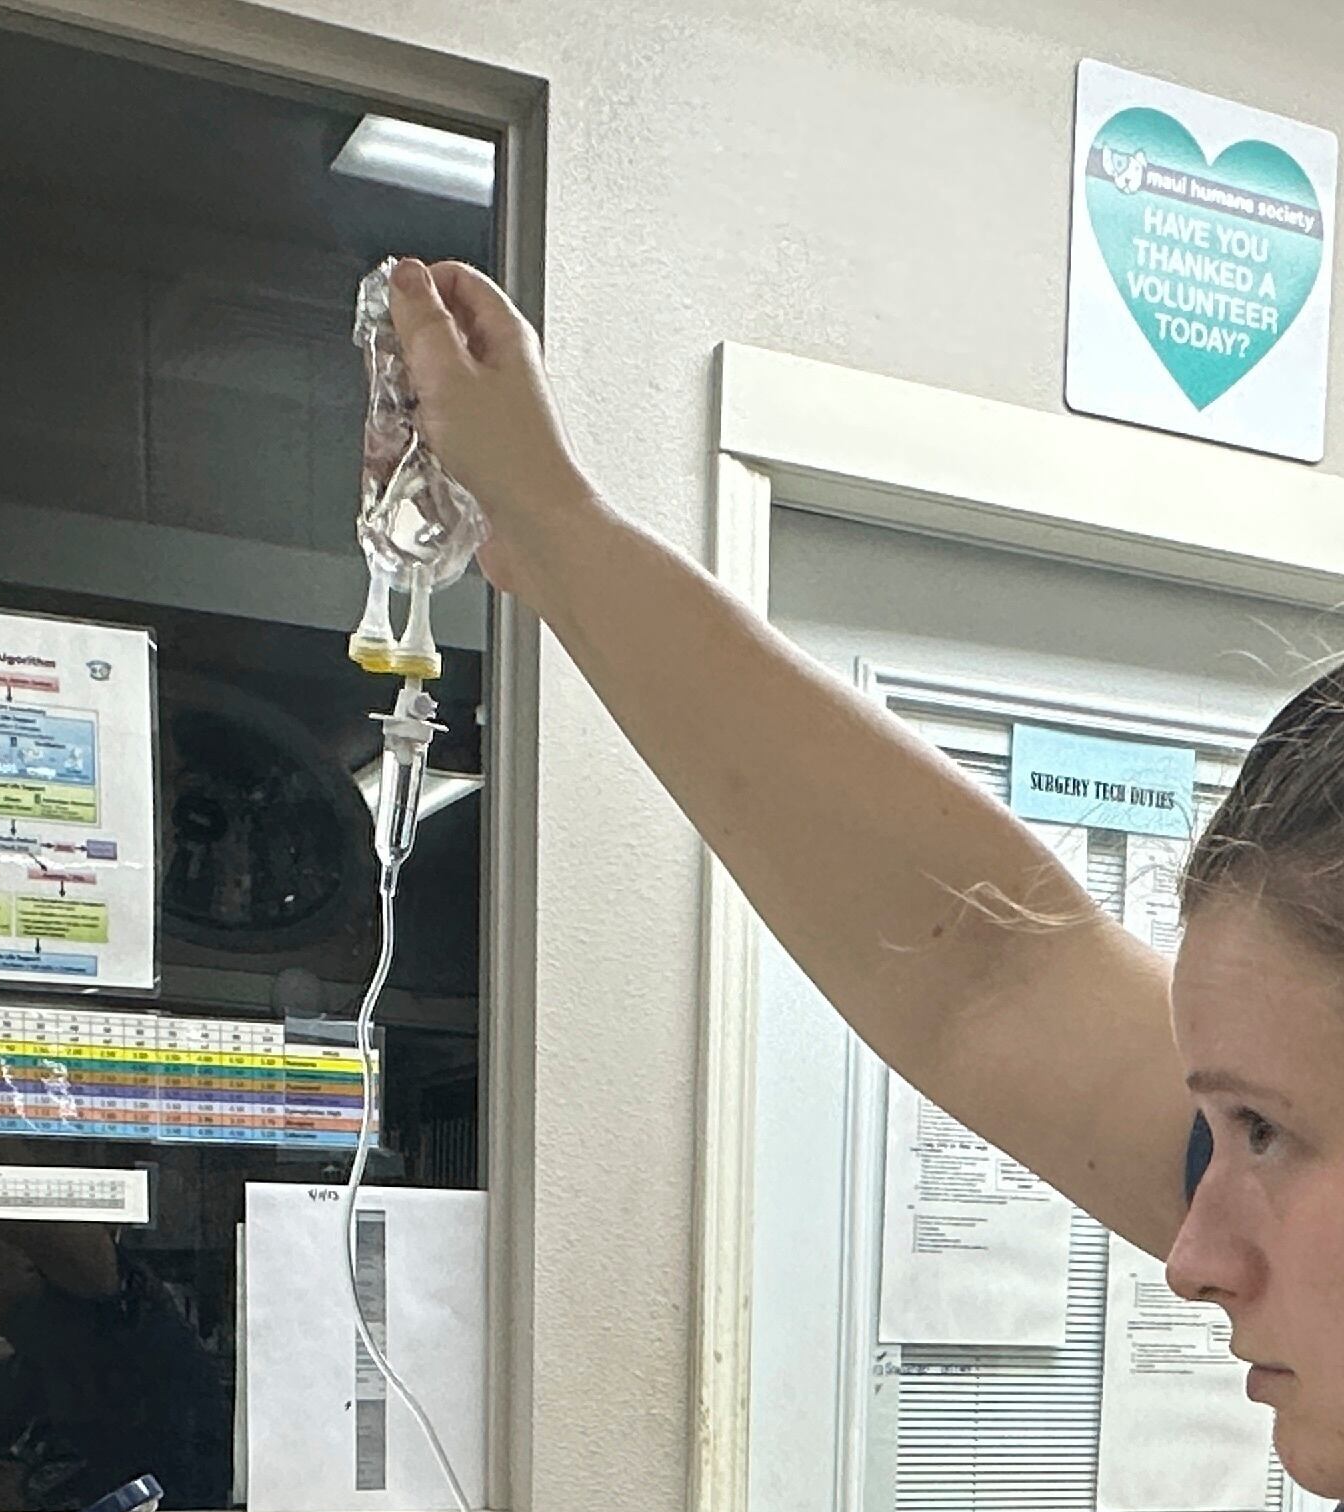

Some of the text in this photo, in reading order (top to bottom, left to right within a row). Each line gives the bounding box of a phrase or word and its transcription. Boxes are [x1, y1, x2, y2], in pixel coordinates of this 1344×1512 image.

[1144, 207, 1269, 263] HAVE YOU
[1258, 195, 1316, 234] society
[1132, 238, 1277, 299] THANKED A
[1127, 272, 1279, 335] VOLUNTEER
[1154, 313, 1251, 358] TODAY?
[1030, 771, 1176, 810] SURGERY TECH DUTIES
